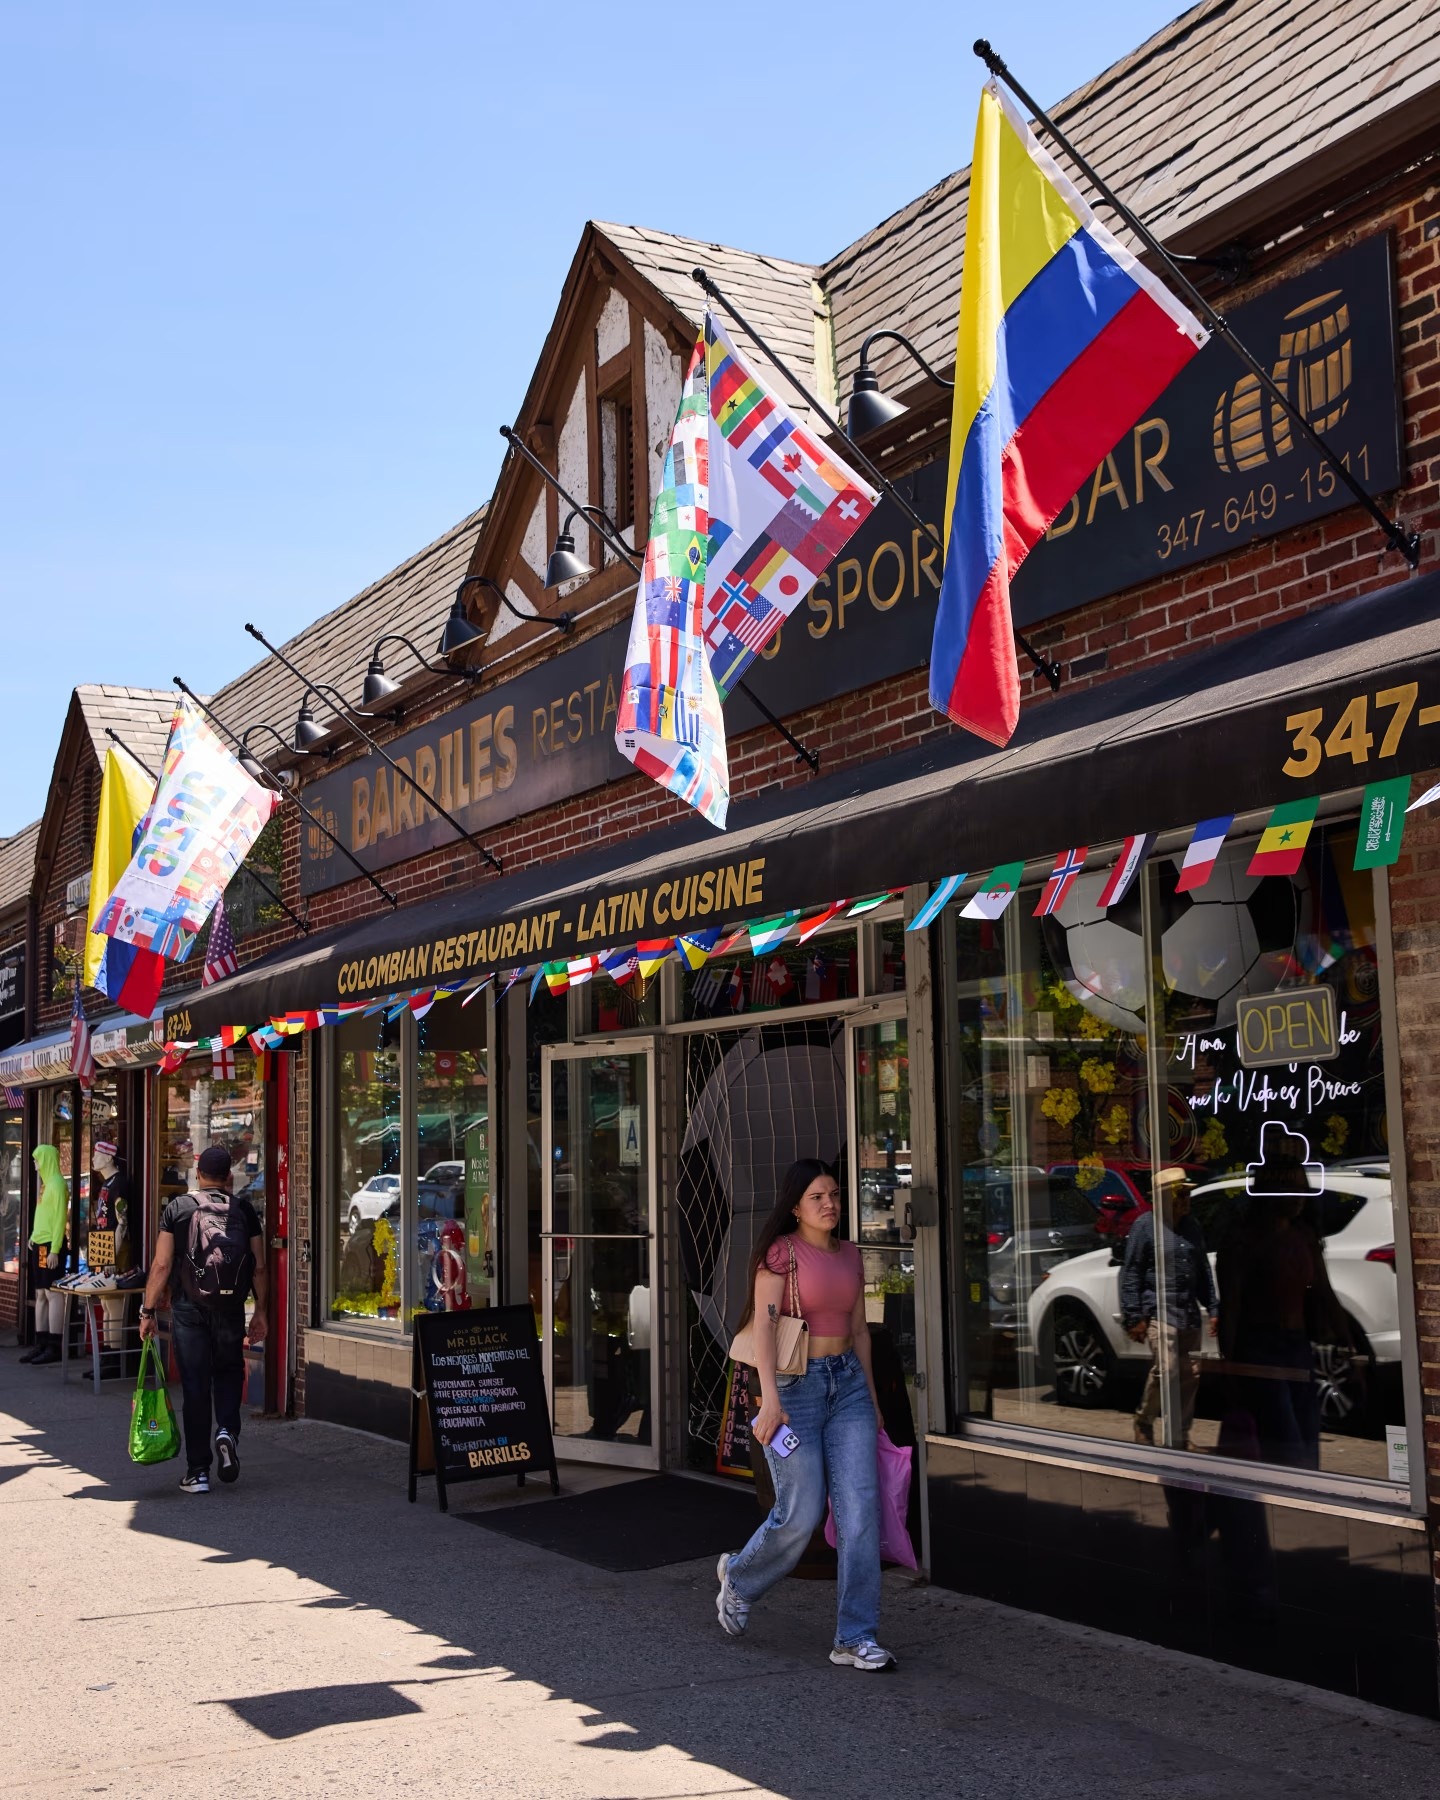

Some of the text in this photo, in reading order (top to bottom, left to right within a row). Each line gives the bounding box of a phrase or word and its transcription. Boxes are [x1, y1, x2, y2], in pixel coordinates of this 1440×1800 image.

[1157, 444, 1370, 559] 347-649-1511
[352, 705, 518, 853] BARRILES
[532, 674, 619, 761] RESTA
[807, 522, 944, 639] SPOR
[337, 941, 430, 995] COLOMBIAN
[431, 910, 561, 973] RESTAURANT
[576, 888, 648, 942] LATIN
[653, 857, 766, 925] CUISINE
[167, 1009, 191, 1041] 83-14
[1243, 998, 1330, 1053] OPEN
[626, 1120, 638, 1150] A
[468, 1441, 531, 1468] BARRILES
